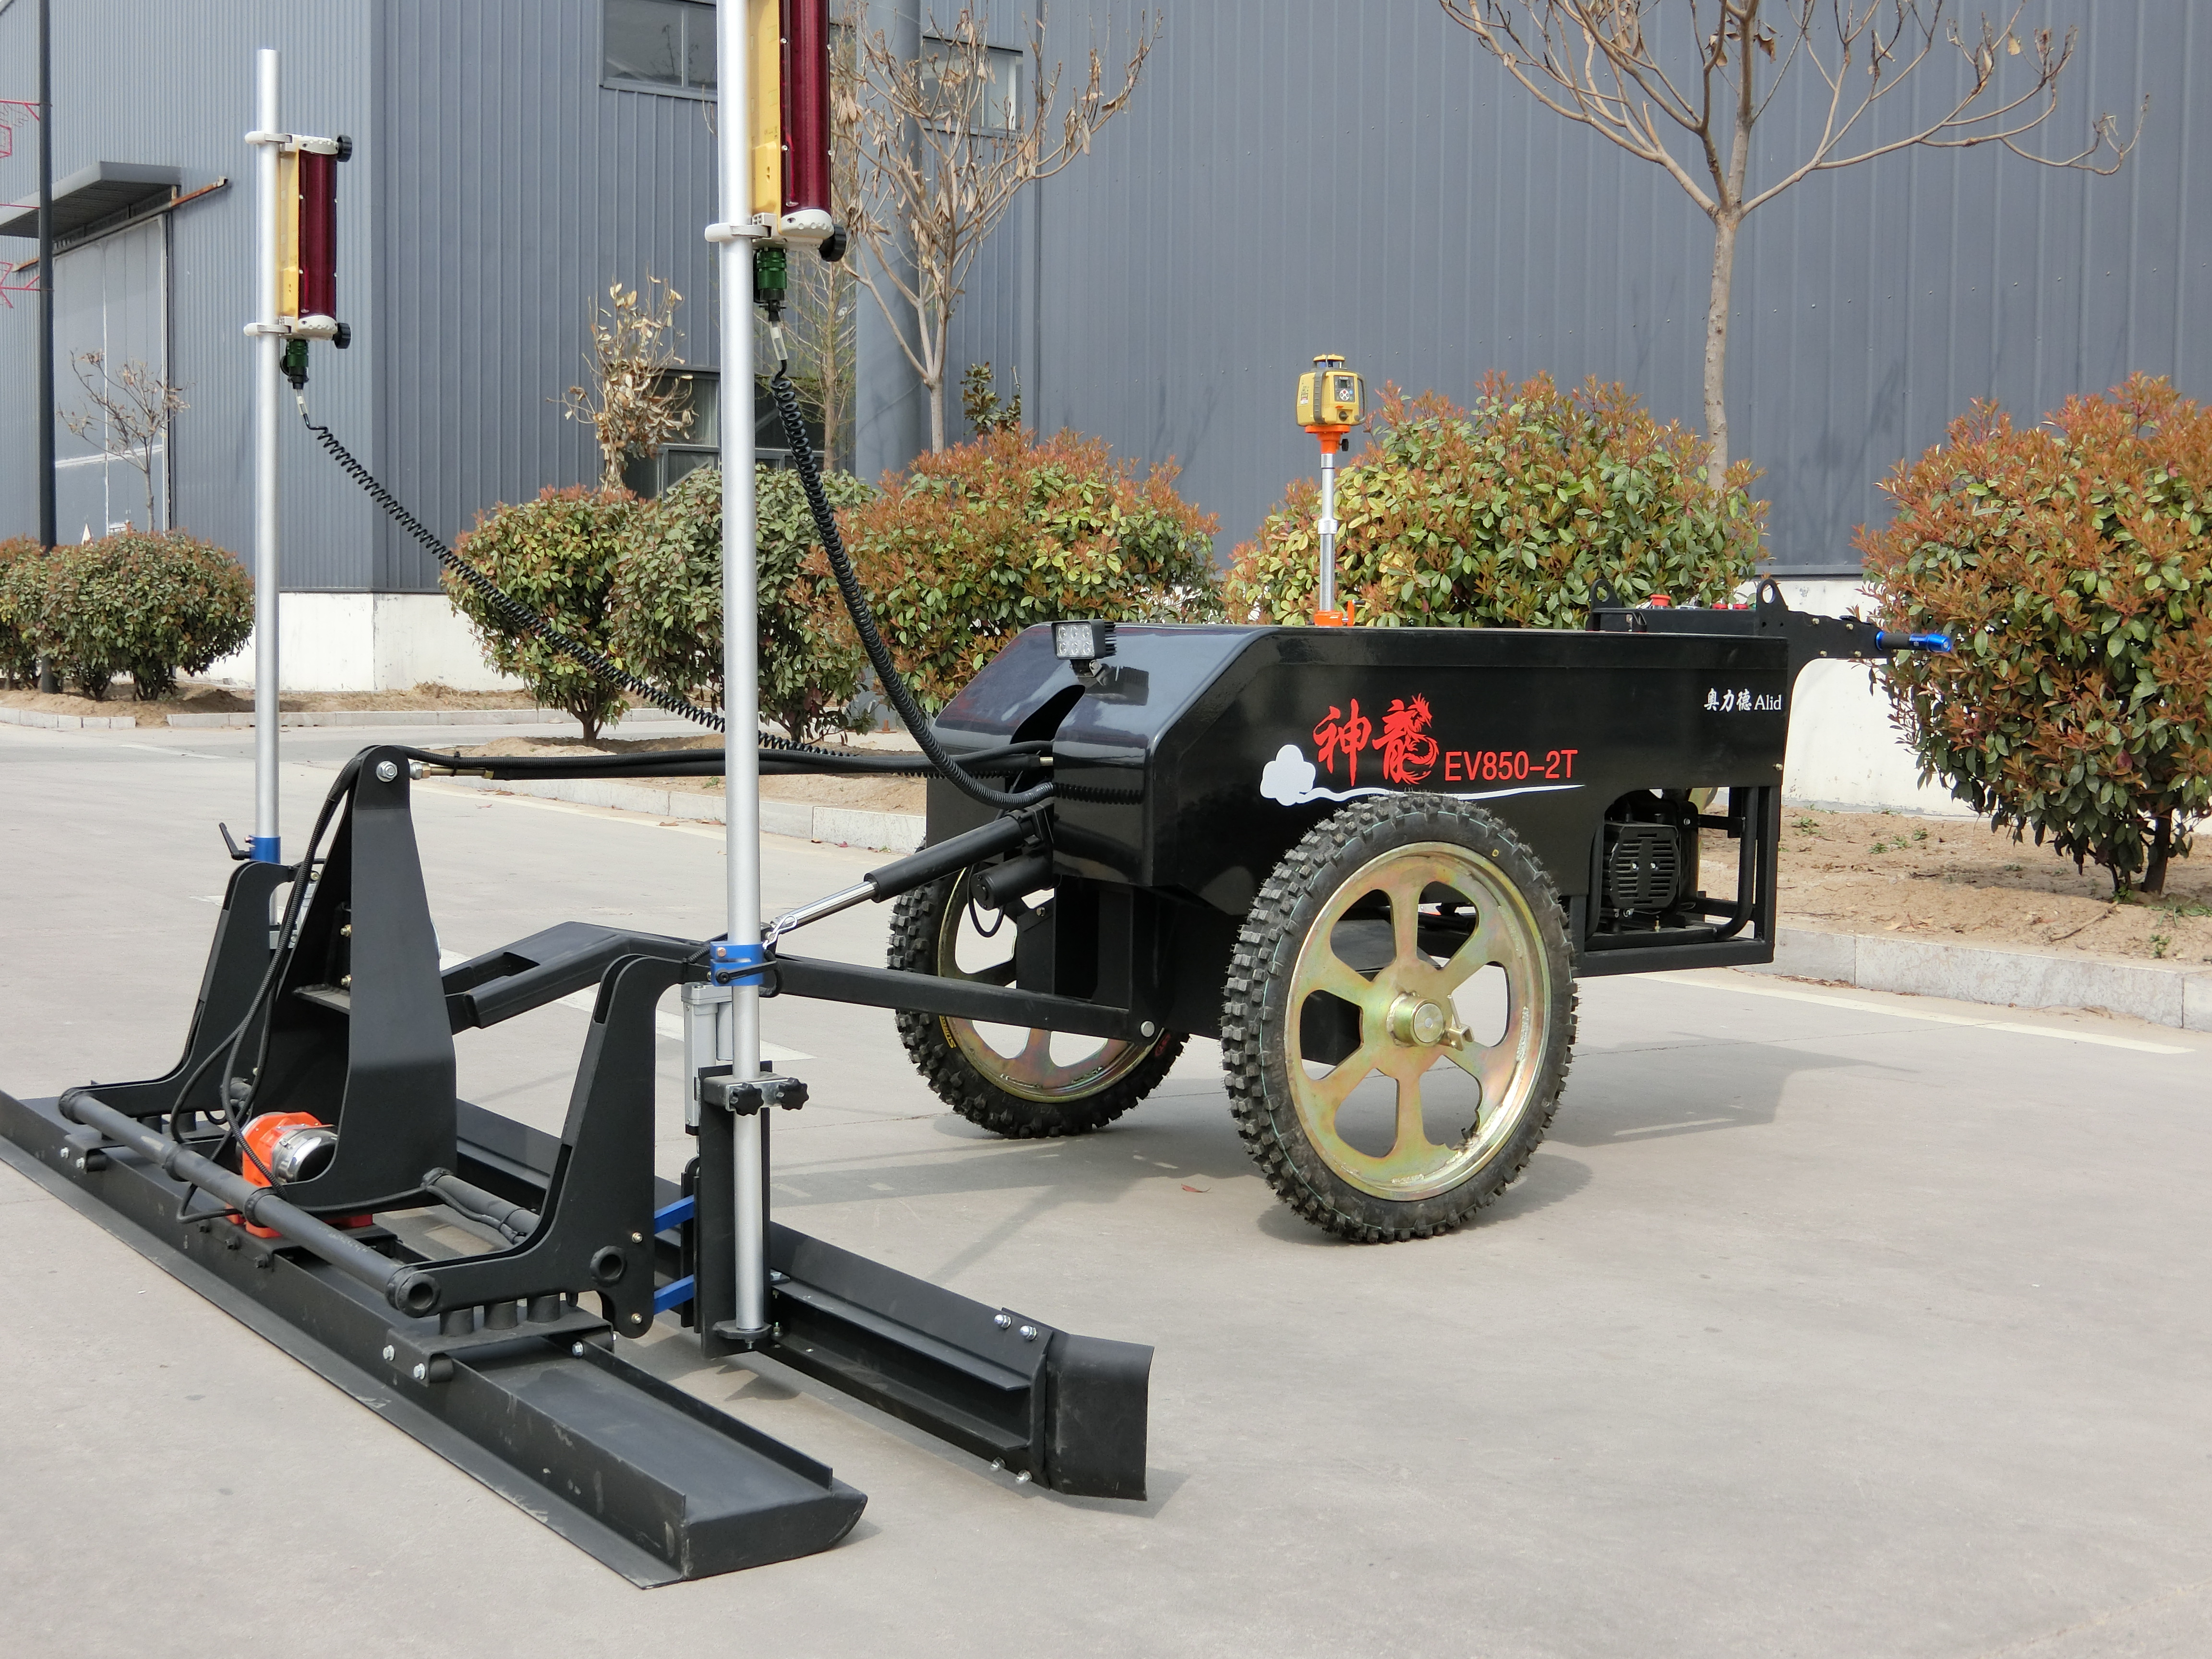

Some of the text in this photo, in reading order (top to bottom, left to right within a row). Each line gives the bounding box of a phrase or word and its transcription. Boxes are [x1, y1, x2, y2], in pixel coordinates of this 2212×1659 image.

[1704, 688, 1752, 712] 奥力德
[1754, 694, 1781, 710] Alid
[1444, 749, 1578, 781] EV850-2T
